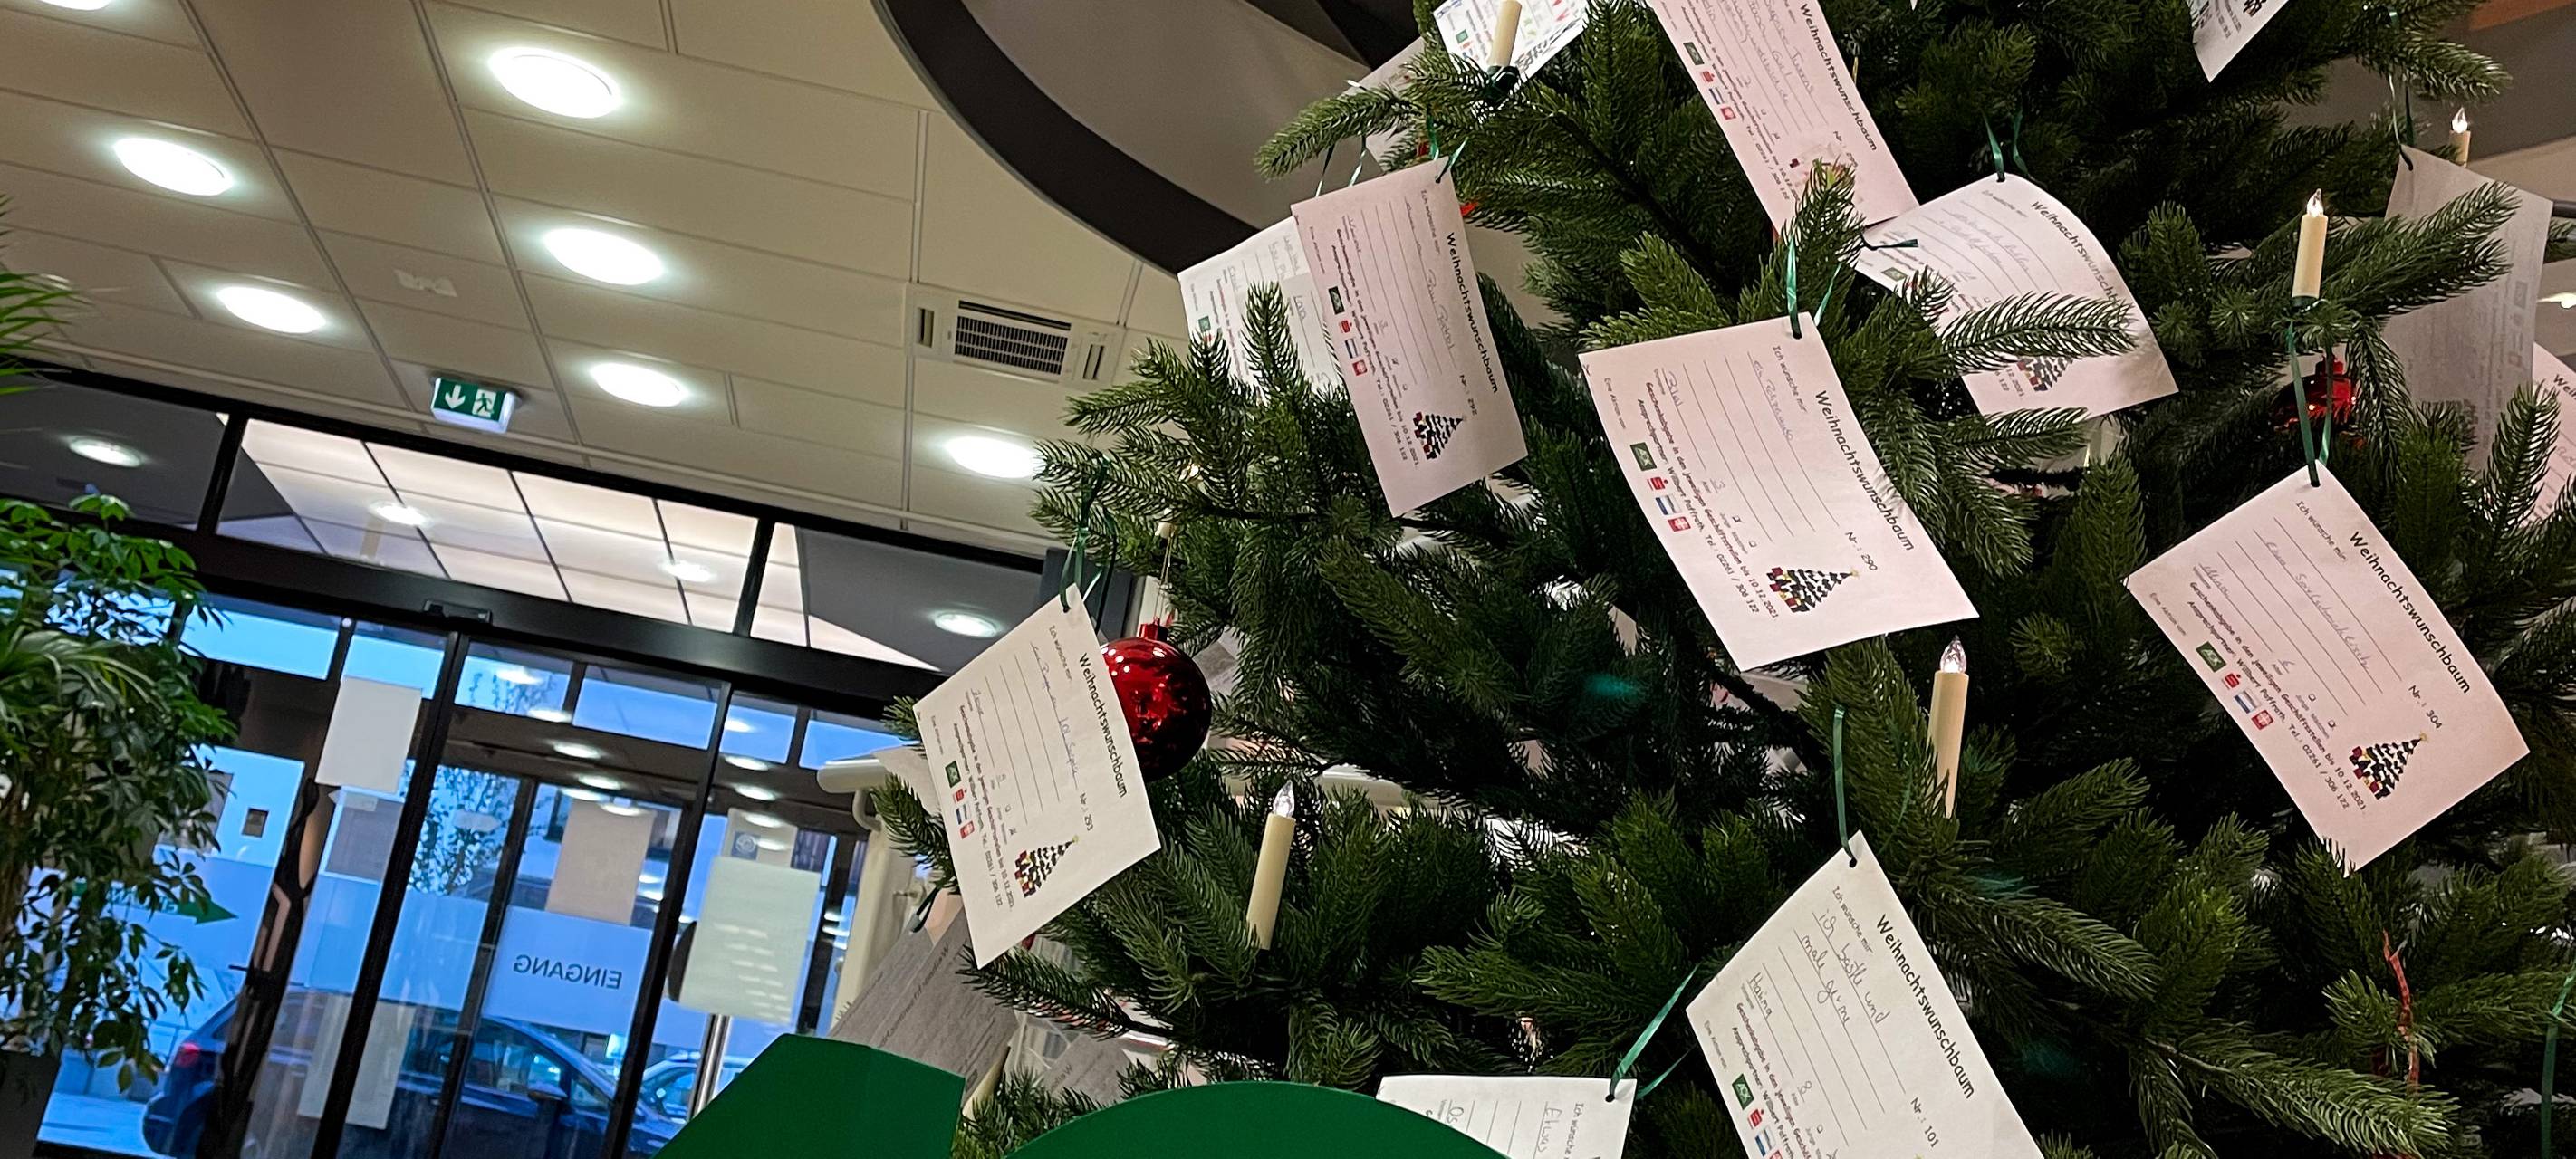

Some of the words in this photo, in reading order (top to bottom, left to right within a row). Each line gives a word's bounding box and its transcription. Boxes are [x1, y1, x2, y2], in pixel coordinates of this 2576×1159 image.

[1800, 3, 1877, 151] Weihnachtswunschbaum
[1447, 232, 1498, 394] Weihnachtswunschbaum
[2031, 201, 2127, 307] Weihnachtswunschb
[1815, 389, 1914, 551] Weihnachtswunschbaum
[1860, 554, 1878, 570] 290
[2350, 531, 2470, 694] Weihnachtswunschbaum
[1079, 652, 1127, 798] Weihnachtswunschbaum
[2302, 744, 2321, 768] 02261
[2324, 776, 2338, 792] 306
[2337, 793, 2350, 809] 122
[2426, 710, 2443, 729] 304
[1877, 914, 1975, 1099] Weihnachtswunschbaum
[1924, 1125, 1939, 1148] 101
